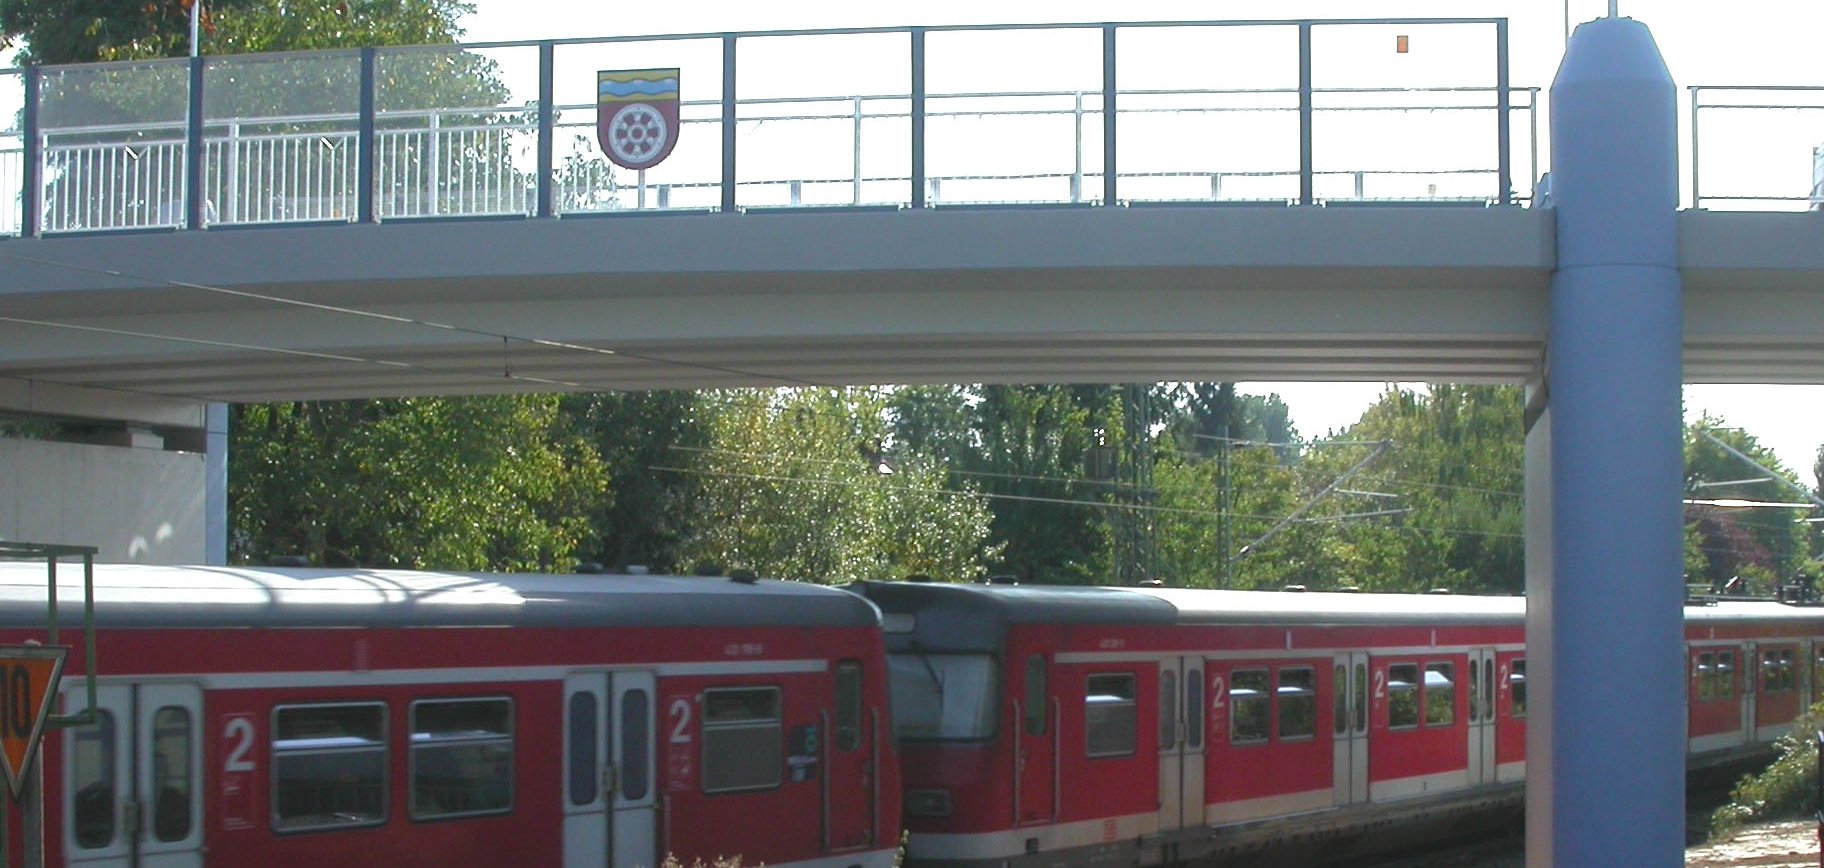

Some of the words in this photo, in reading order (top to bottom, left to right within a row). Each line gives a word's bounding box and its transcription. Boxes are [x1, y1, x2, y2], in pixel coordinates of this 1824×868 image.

[1213, 677, 1224, 708] 2
[1375, 671, 1385, 698] 2
[1500, 665, 1509, 689] 2
[671, 701, 691, 744] 2
[224, 718, 256, 772] 2
